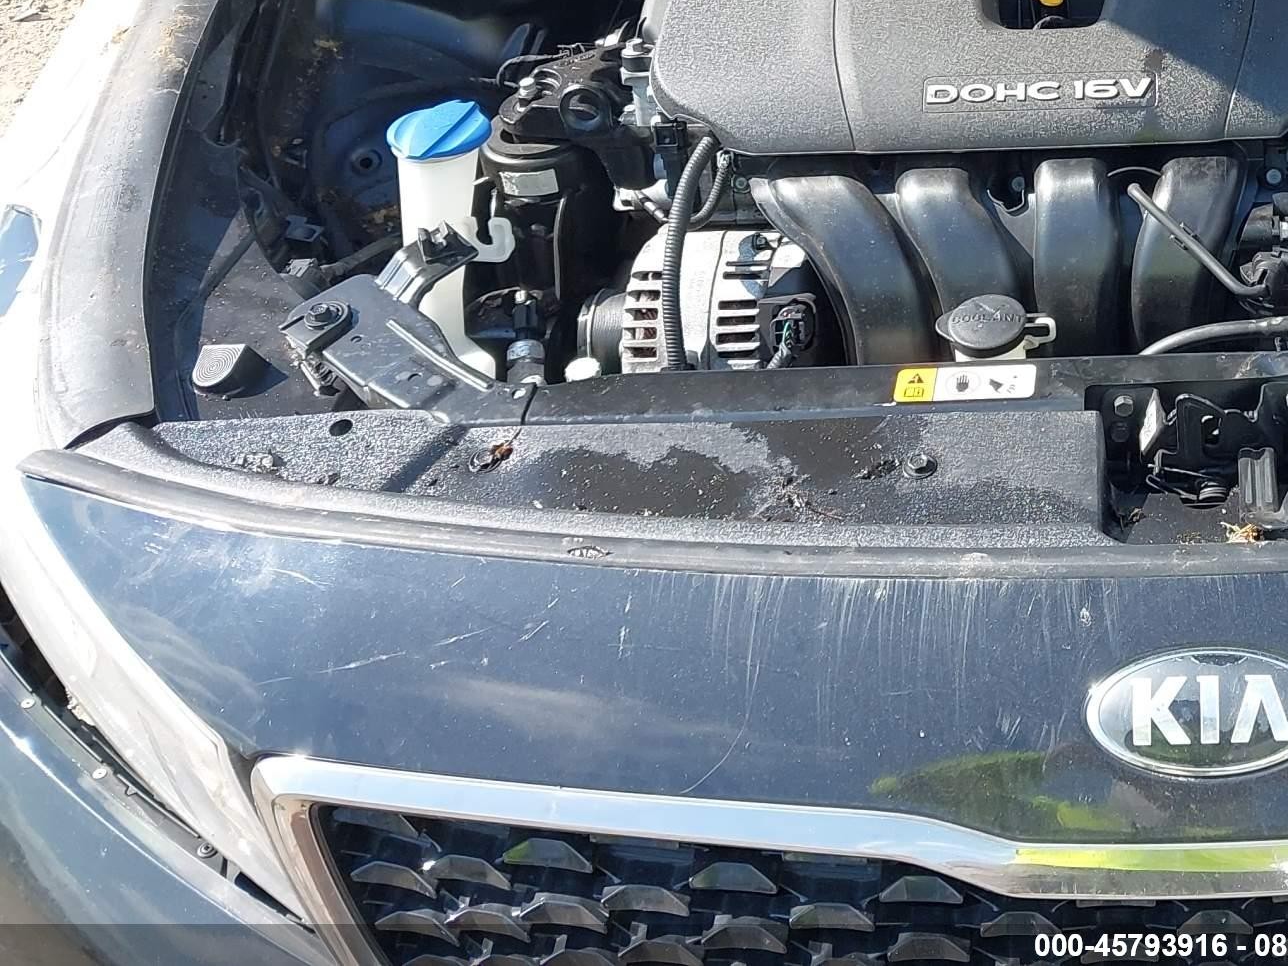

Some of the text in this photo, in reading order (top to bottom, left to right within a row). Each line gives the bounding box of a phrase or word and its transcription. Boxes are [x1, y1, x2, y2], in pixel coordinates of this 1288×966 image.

[925, 77, 1152, 105] DOHC 16V
[951, 312, 1022, 325] COOLANT
